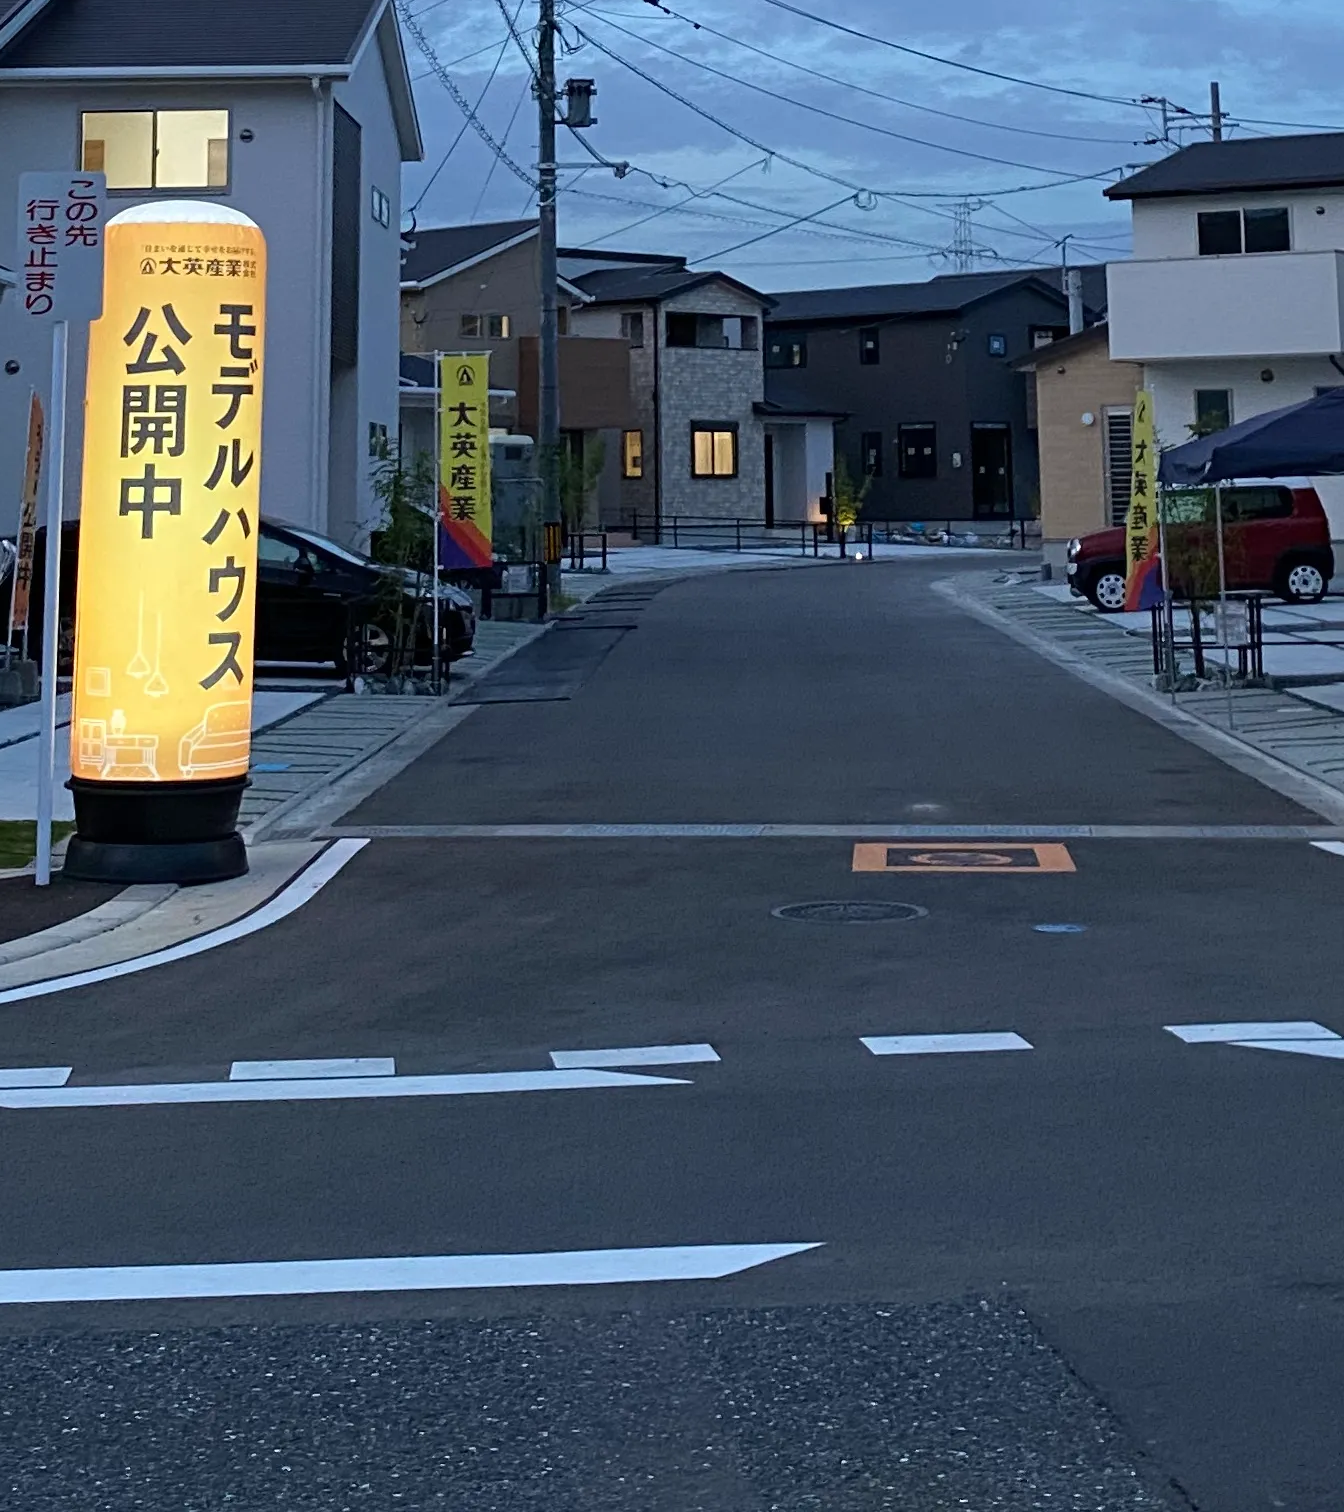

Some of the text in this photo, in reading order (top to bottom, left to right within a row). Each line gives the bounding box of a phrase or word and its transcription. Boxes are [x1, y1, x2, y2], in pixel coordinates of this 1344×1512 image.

[25, 199, 59, 316] 行き止まり
[65, 180, 98, 247] この先
[118, 303, 193, 541] 公開中
[449, 402, 477, 521] 大英産業
[199, 303, 258, 691] モデルハウス
